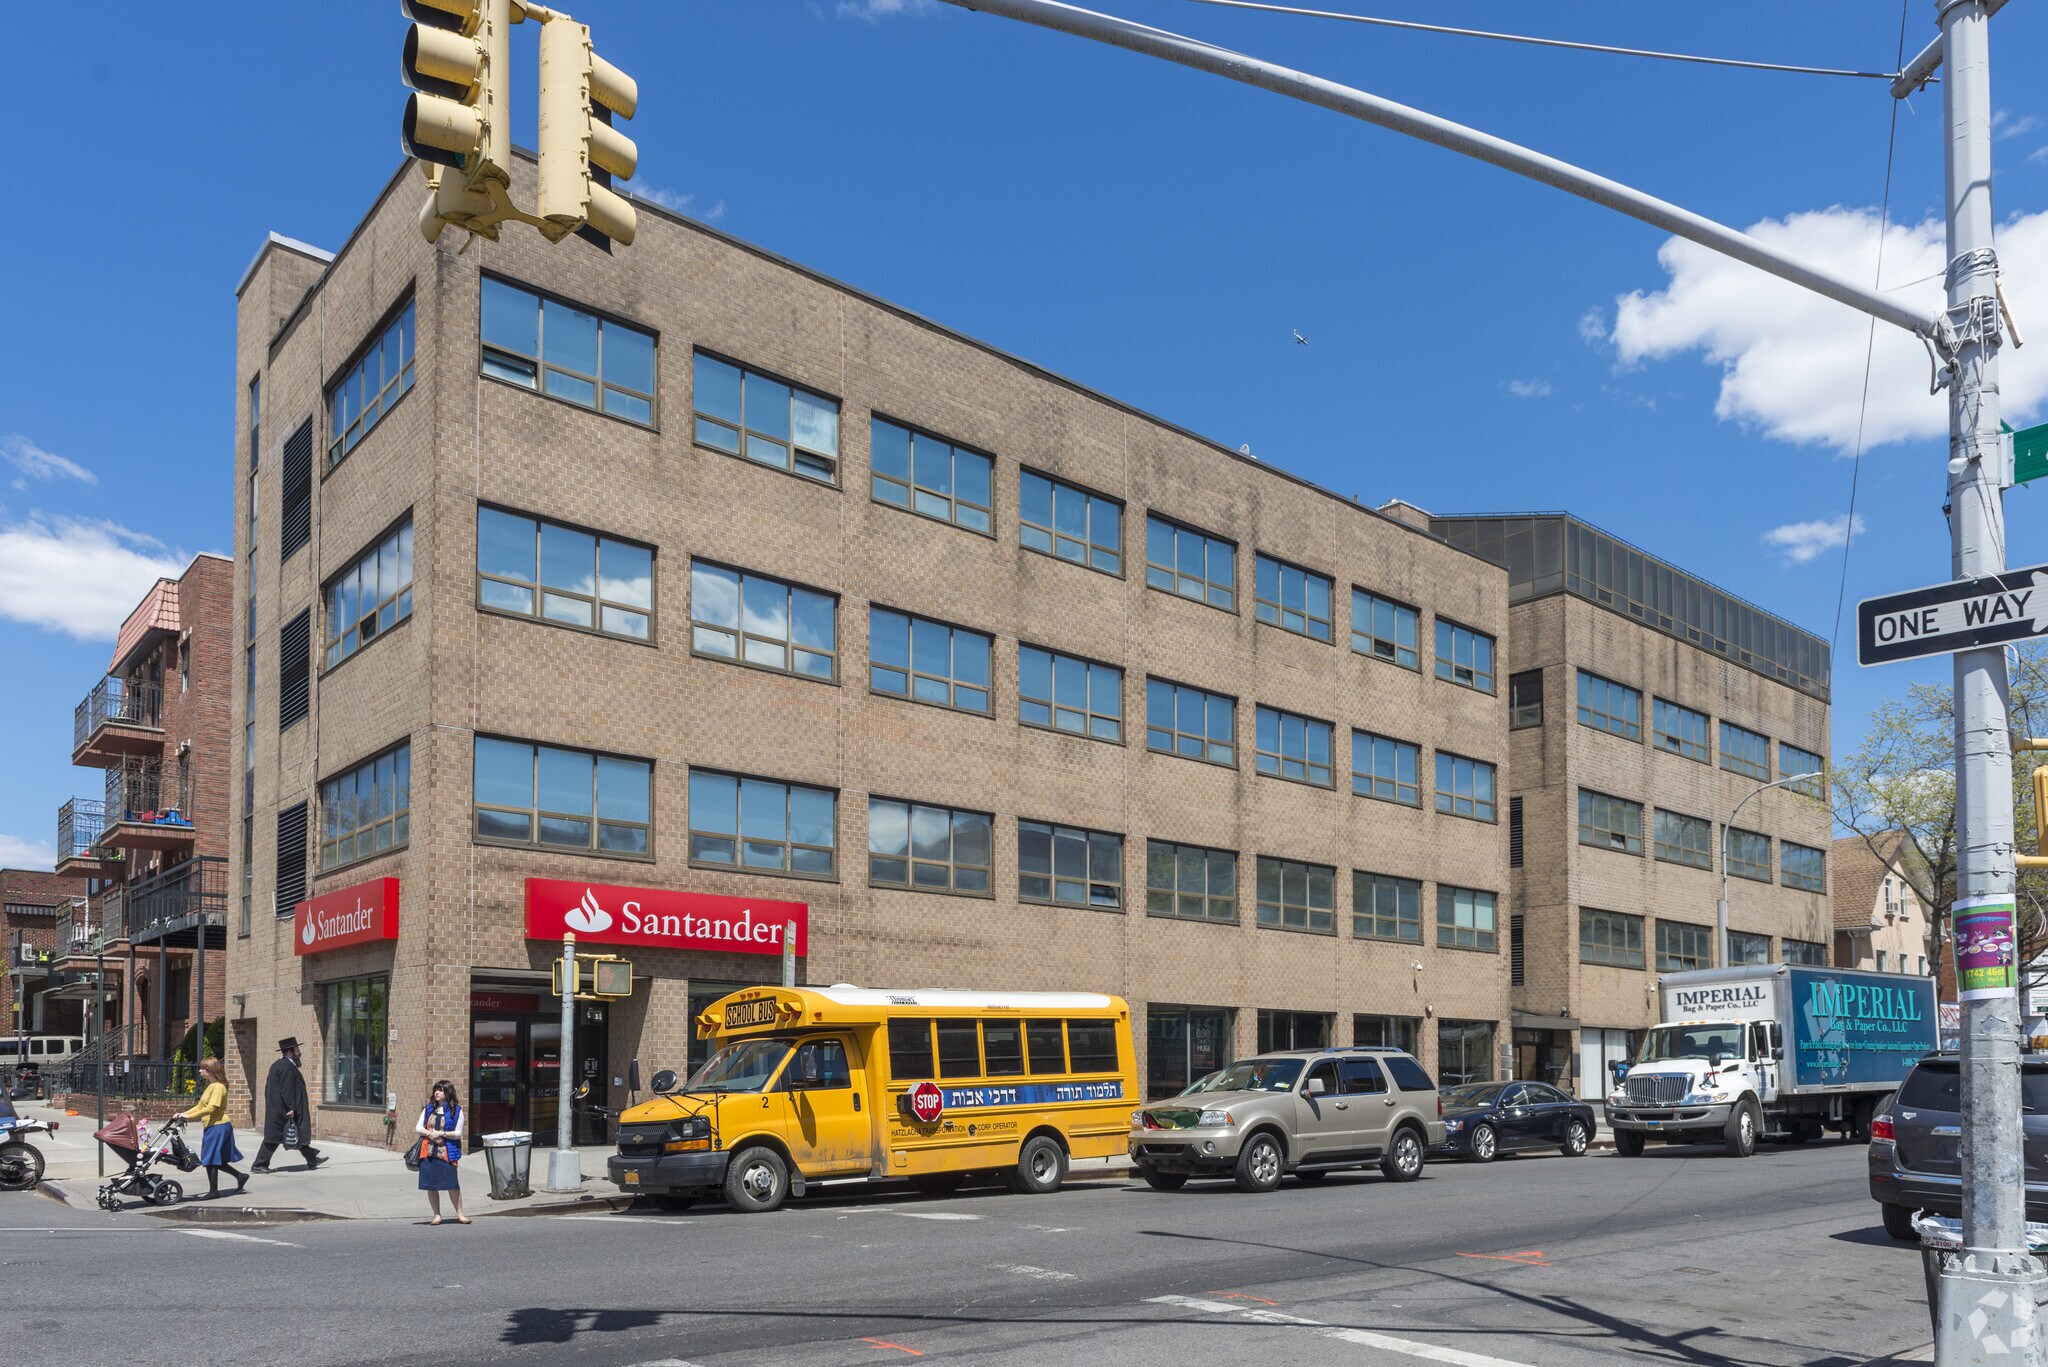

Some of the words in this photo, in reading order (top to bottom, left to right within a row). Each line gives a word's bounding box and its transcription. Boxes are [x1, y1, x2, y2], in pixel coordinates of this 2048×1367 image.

[1878, 607, 1940, 642] ONE
[1963, 590, 2034, 627] WAY
[317, 897, 373, 941] Santander
[622, 901, 782, 944] Santander
[1676, 986, 1766, 1006] IMPERIAL
[1809, 981, 1921, 1021] IMPERIAL
[727, 1003, 755, 1026] SCHOOL
[758, 1000, 774, 1022] BUS
[1683, 1005, 1696, 1013] Bag
[1705, 1003, 1725, 1012] Paper
[1743, 1000, 1758, 1008] LLC
[1830, 1018, 1845, 1035] Bag
[1846, 1021, 1852, 1030] &
[1855, 1019, 1876, 1035] Paper
[1892, 1021, 1908, 1033] LLC
[951, 1089, 984, 1106] אבות
[988, 1088, 1016, 1103] דרכי
[1056, 1085, 1083, 1100] תורה
[1086, 1082, 1117, 1099] תלמוד
[761, 1096, 769, 1109] 2
[917, 1093, 939, 1109] STOP
[993, 1121, 1018, 1130] OPERATOR
